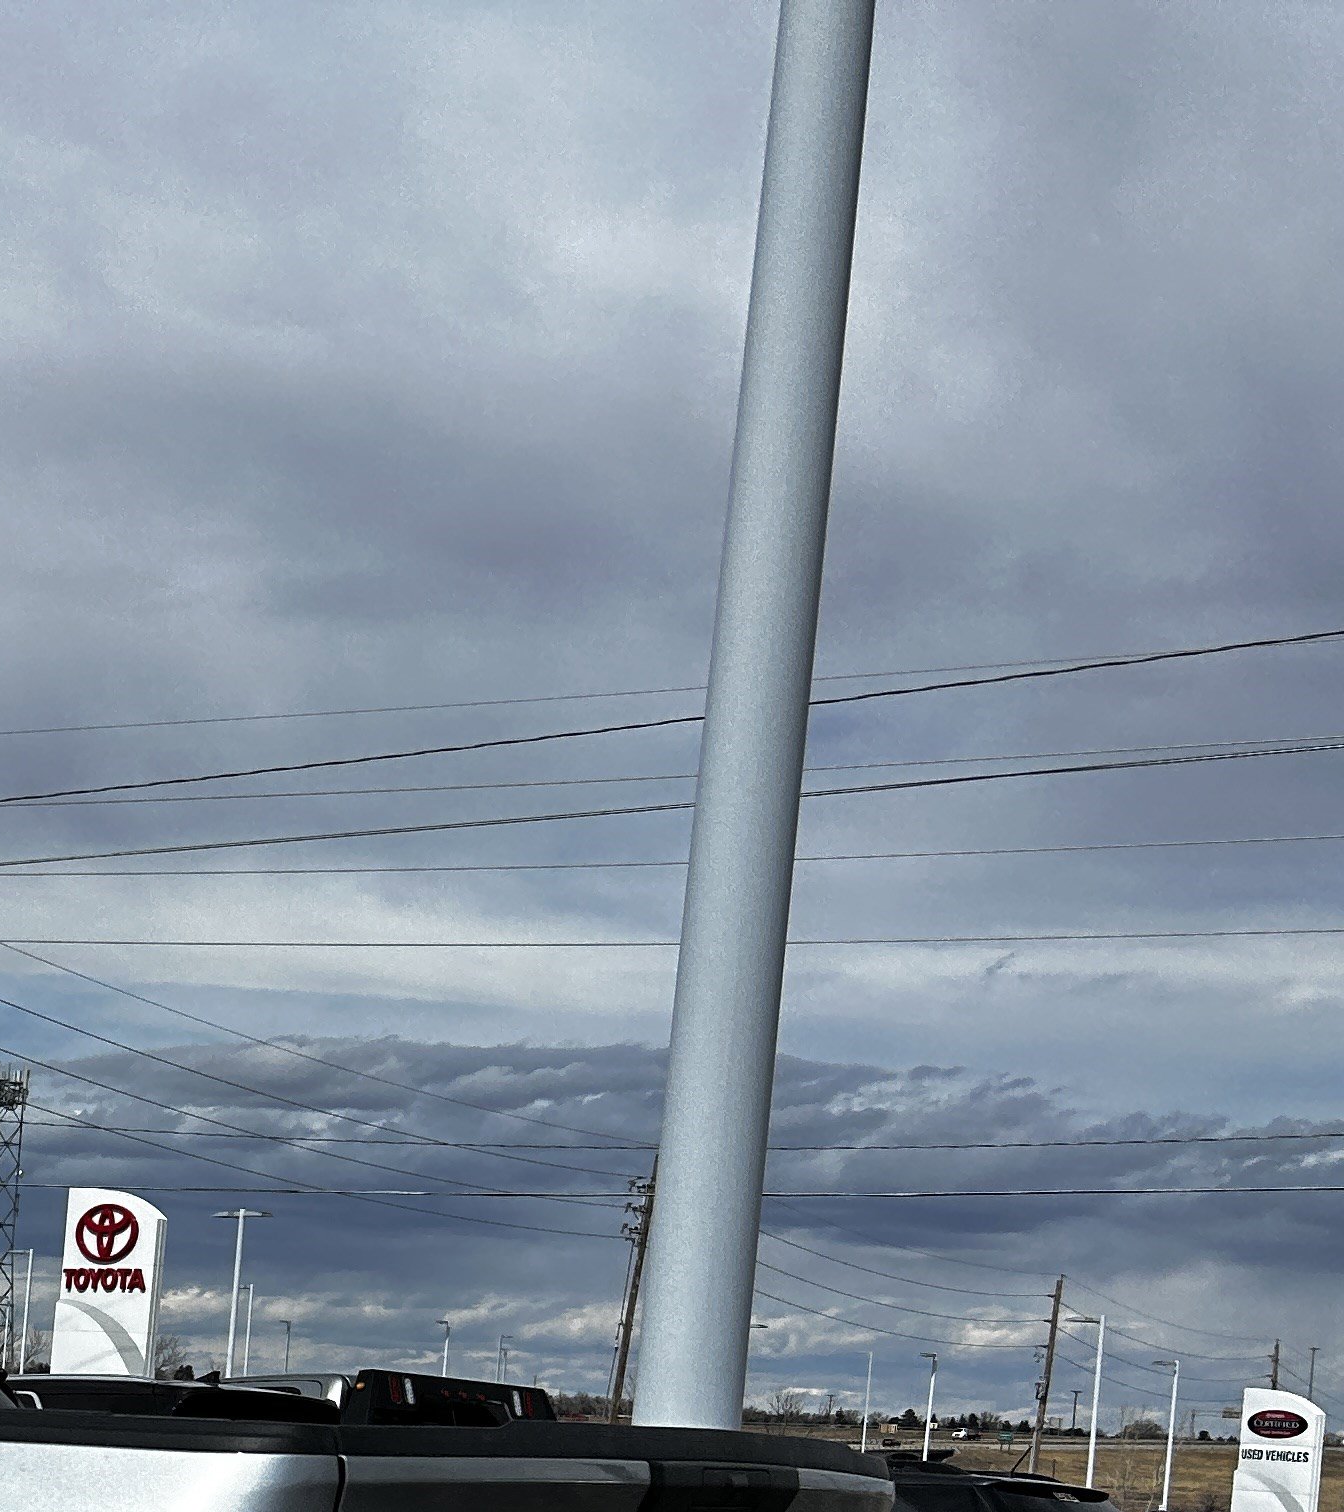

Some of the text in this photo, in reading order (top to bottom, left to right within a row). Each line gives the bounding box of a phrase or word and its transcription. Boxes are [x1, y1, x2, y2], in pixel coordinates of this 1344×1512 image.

[63, 1268, 146, 1293] TOYOTA
[1241, 1449, 1310, 1463] USED VEHICLES
